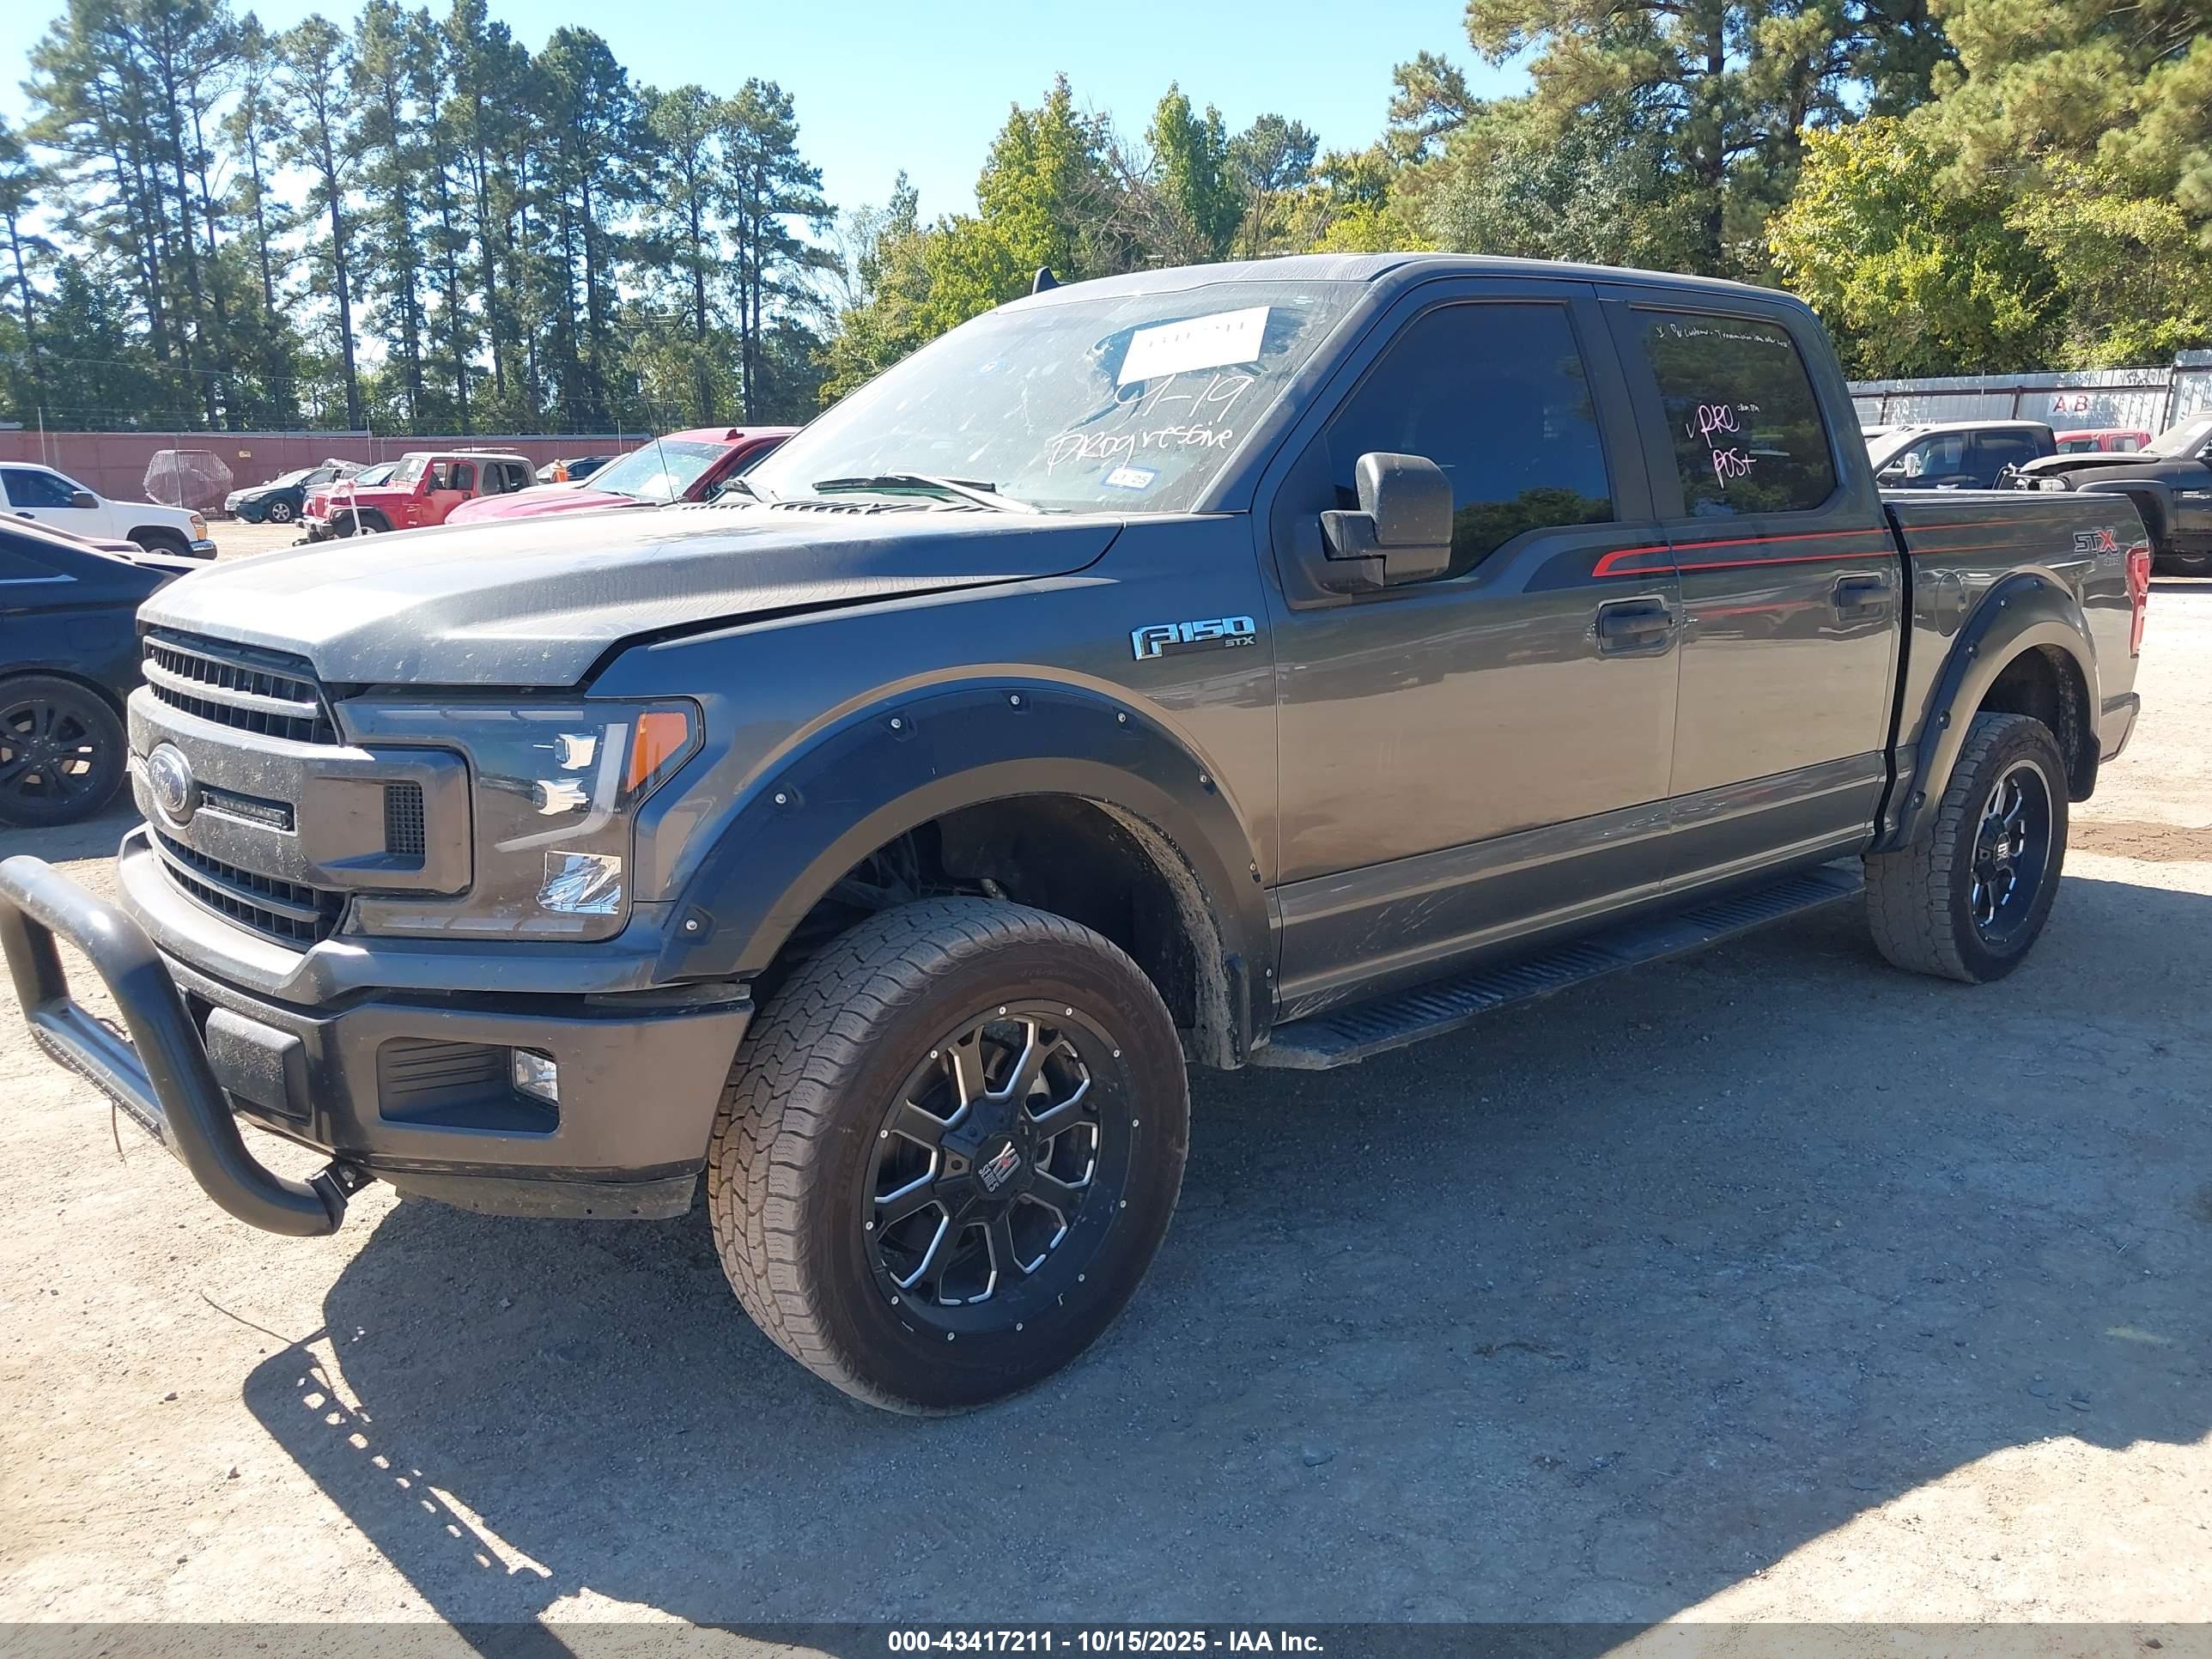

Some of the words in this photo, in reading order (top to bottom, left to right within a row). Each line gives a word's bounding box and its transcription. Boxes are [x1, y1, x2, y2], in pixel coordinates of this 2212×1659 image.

[2052, 395, 2067, 412] A
[2075, 395, 2088, 412] B
[2073, 526, 2119, 556] STX
[1224, 635, 1255, 647] STX
[978, 1164, 1000, 1192] SERIES
